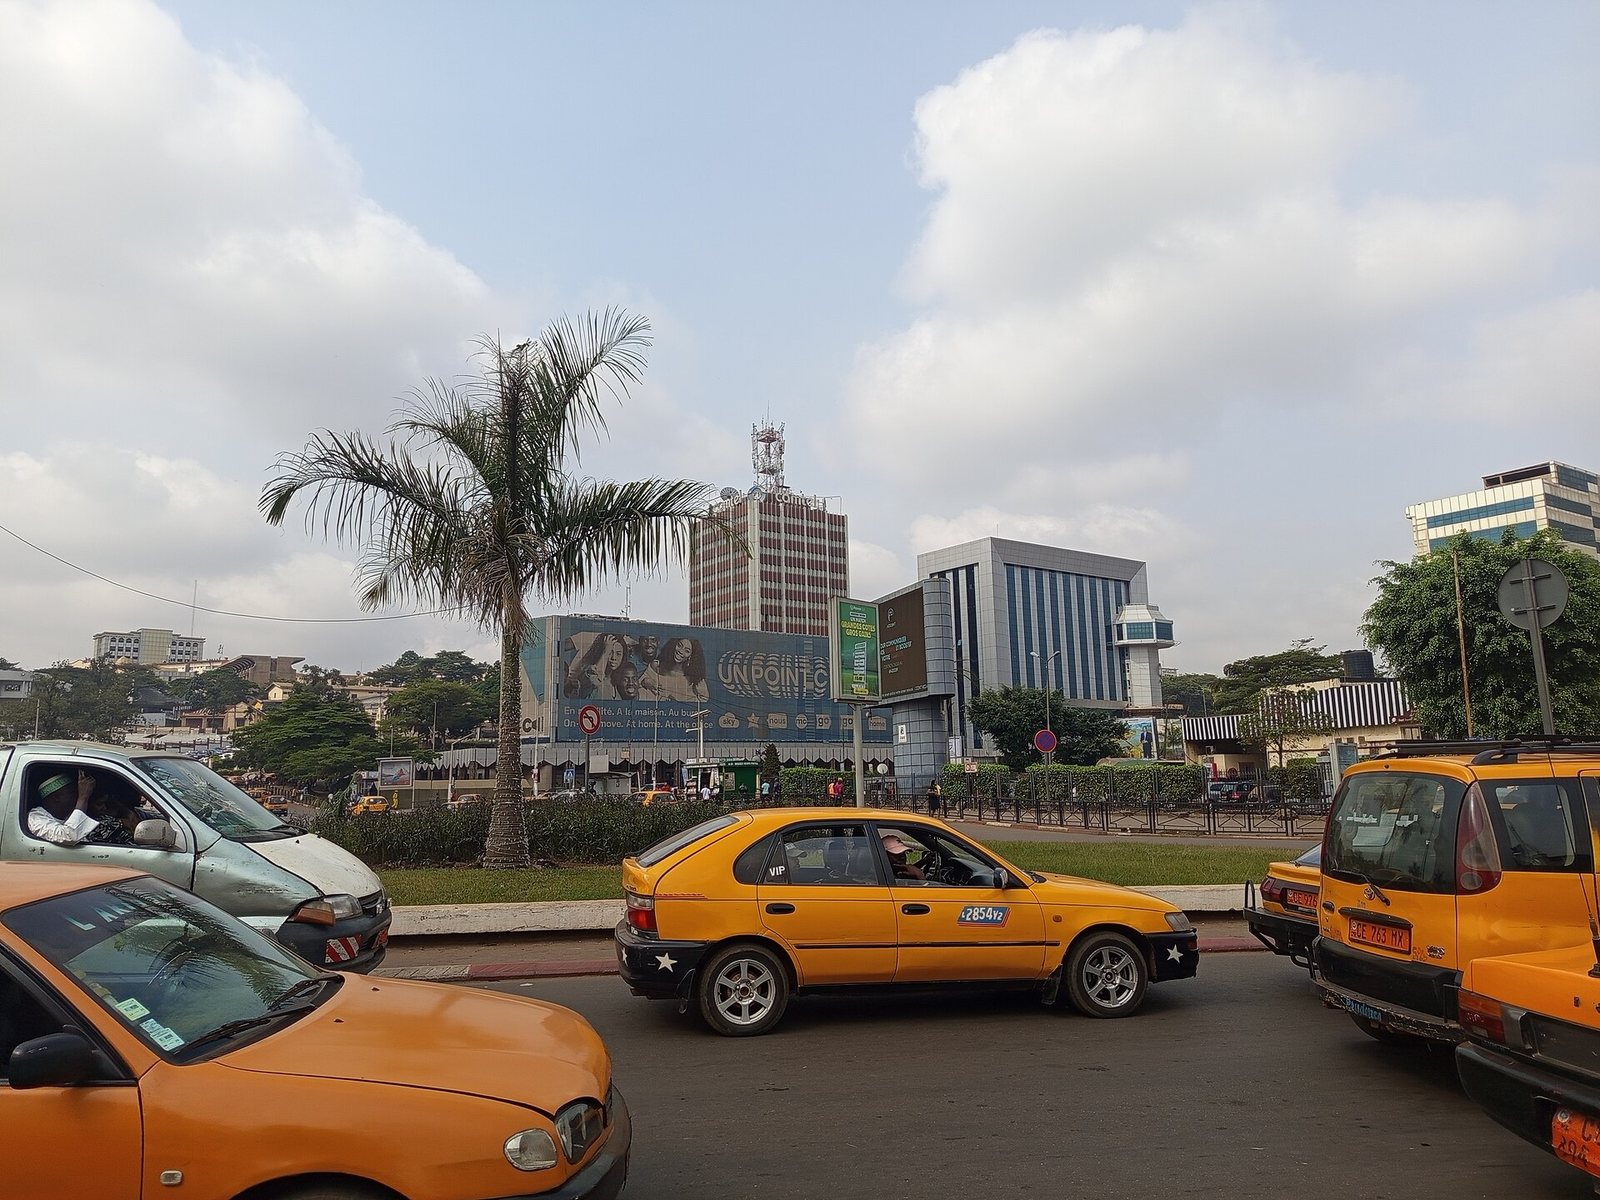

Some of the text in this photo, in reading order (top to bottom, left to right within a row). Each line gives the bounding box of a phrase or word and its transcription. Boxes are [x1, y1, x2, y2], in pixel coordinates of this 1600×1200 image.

[564, 706, 576, 715] En
[668, 708, 679, 717] Au
[665, 720, 674, 728] At
[676, 720, 690, 728] the
[722, 717, 735, 727] sky
[769, 717, 786, 725] nous
[842, 718, 854, 727] go
[769, 865, 786, 877] VIP
[1355, 923, 1367, 940] CE
[1371, 927, 1387, 945] 763
[1390, 929, 1405, 948] MX
